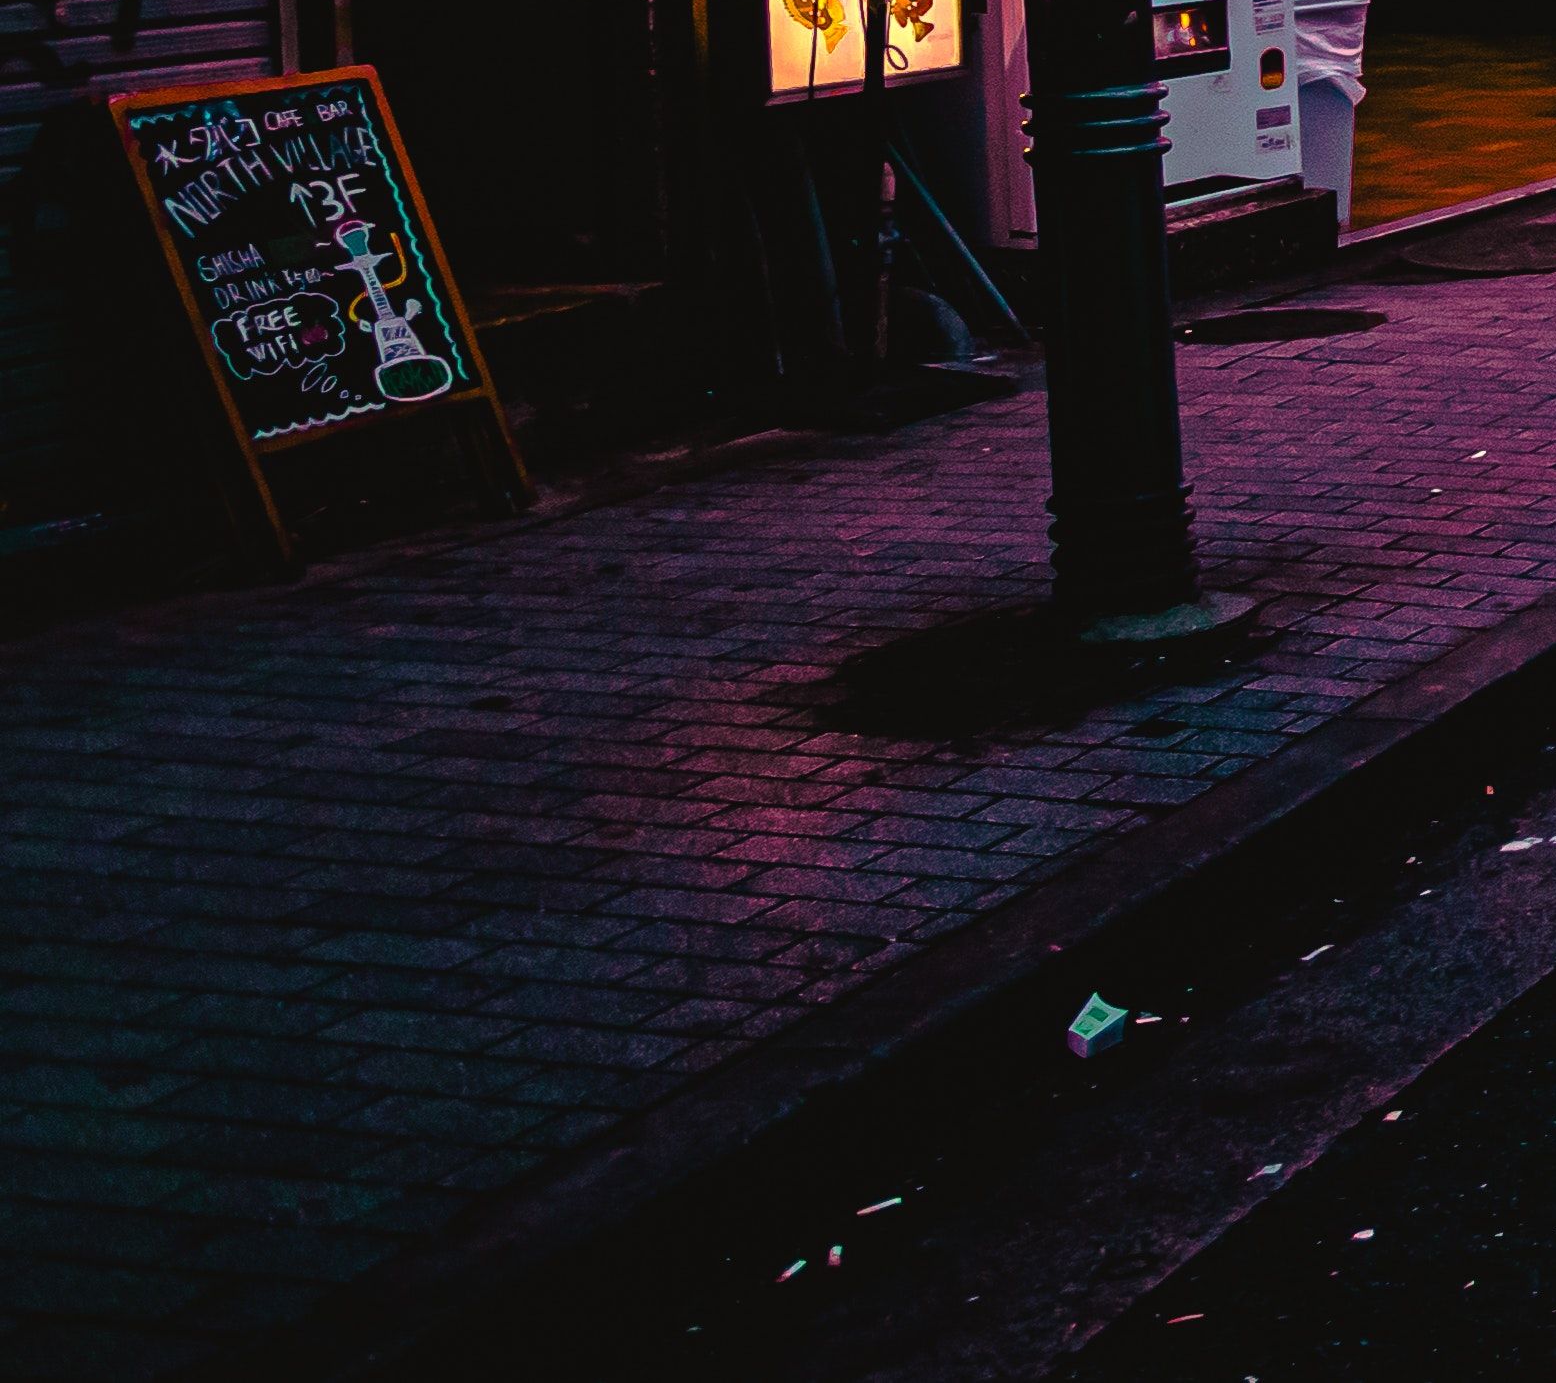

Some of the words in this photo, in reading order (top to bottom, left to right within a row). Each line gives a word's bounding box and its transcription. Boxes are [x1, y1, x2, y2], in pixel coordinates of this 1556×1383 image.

[263, 109, 304, 130] CAFE
[317, 101, 352, 121] BAR
[309, 173, 367, 222] 3F
[236, 306, 302, 342] FREE
[247, 333, 298, 362] WIFI
